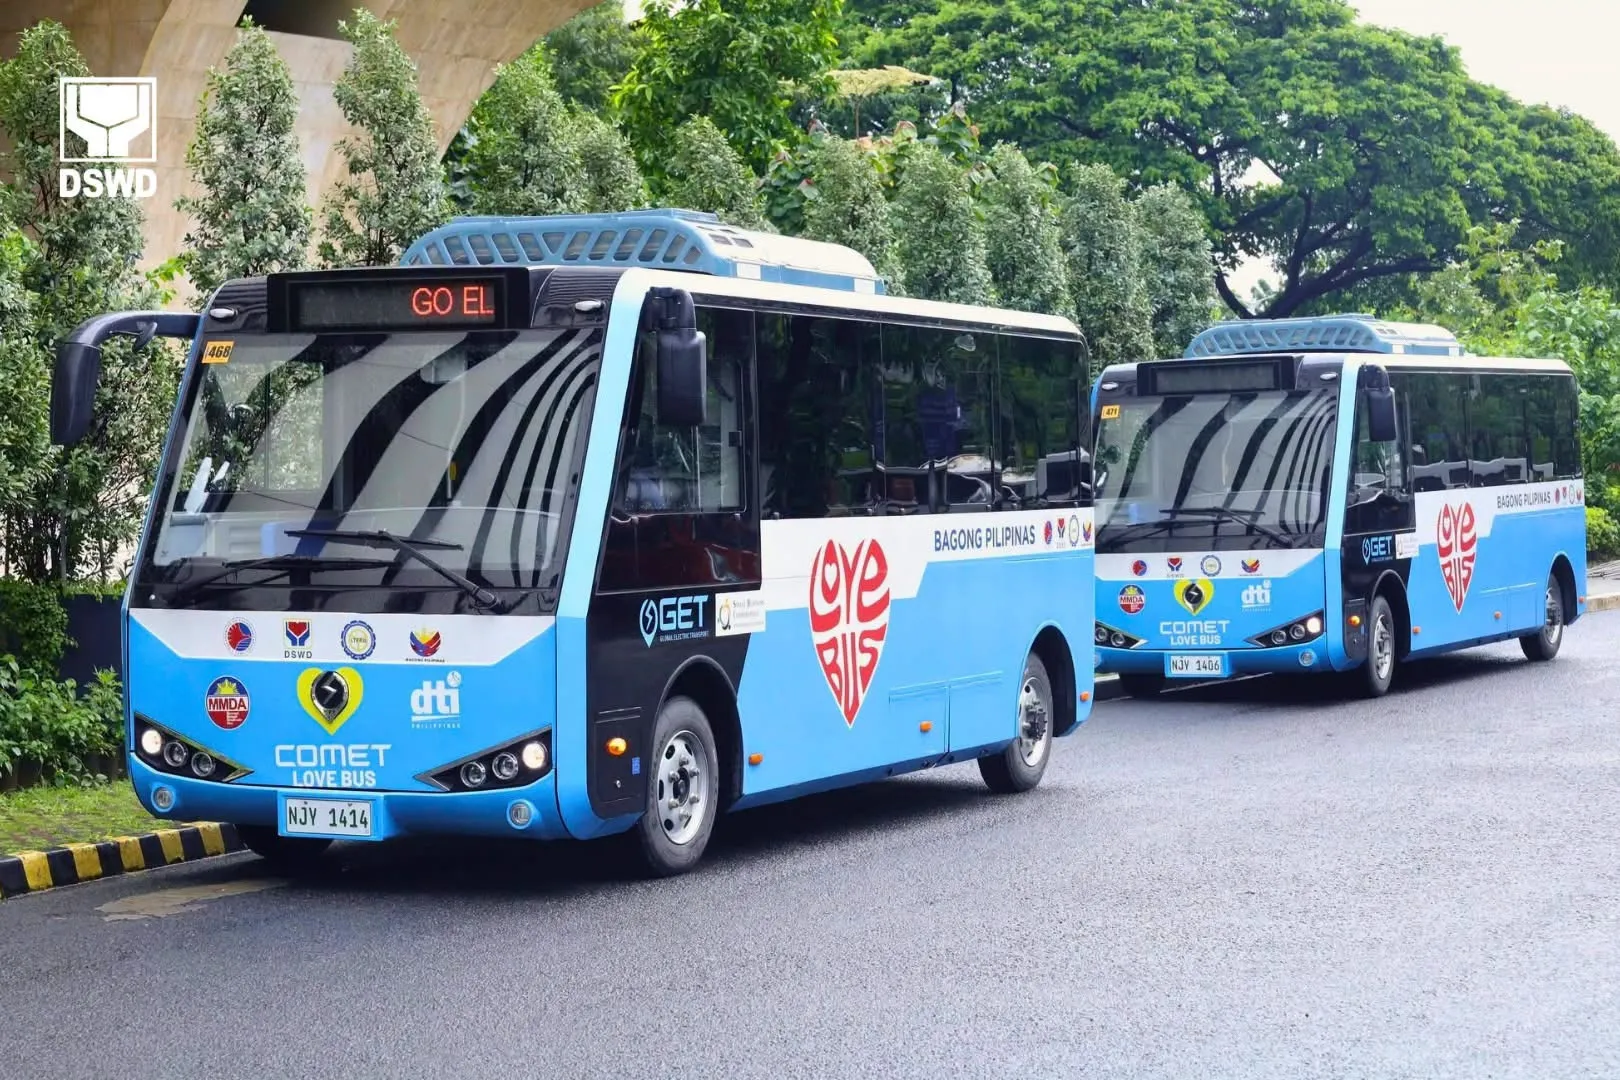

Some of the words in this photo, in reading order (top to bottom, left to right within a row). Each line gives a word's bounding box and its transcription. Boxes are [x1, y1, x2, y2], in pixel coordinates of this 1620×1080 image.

[412, 287, 453, 315] GO
[463, 285, 494, 315] EL
[208, 345, 231, 359] 468
[1497, 493, 1522, 509] BAGONG
[1523, 491, 1551, 506] PILIPINAS
[934, 527, 983, 552] BAGONG
[985, 524, 1036, 548] PILIPINAS
[1370, 535, 1393, 556] GET
[1120, 595, 1144, 604] MMDA
[1241, 579, 1271, 604] dti
[659, 594, 709, 631] GET
[1159, 620, 1231, 635] COMET
[1170, 635, 1197, 646] LOVE
[1200, 634, 1221, 645] BUS
[284, 650, 313, 660] DSWD
[1196, 659, 1220, 671] 1406
[410, 671, 462, 714] dti
[208, 698, 248, 711] MMDA
[275, 743, 392, 767] COMET
[292, 769, 337, 788] LOVE
[341, 770, 376, 788] BUS
[288, 805, 317, 826] NJY
[328, 808, 369, 829] 1414
